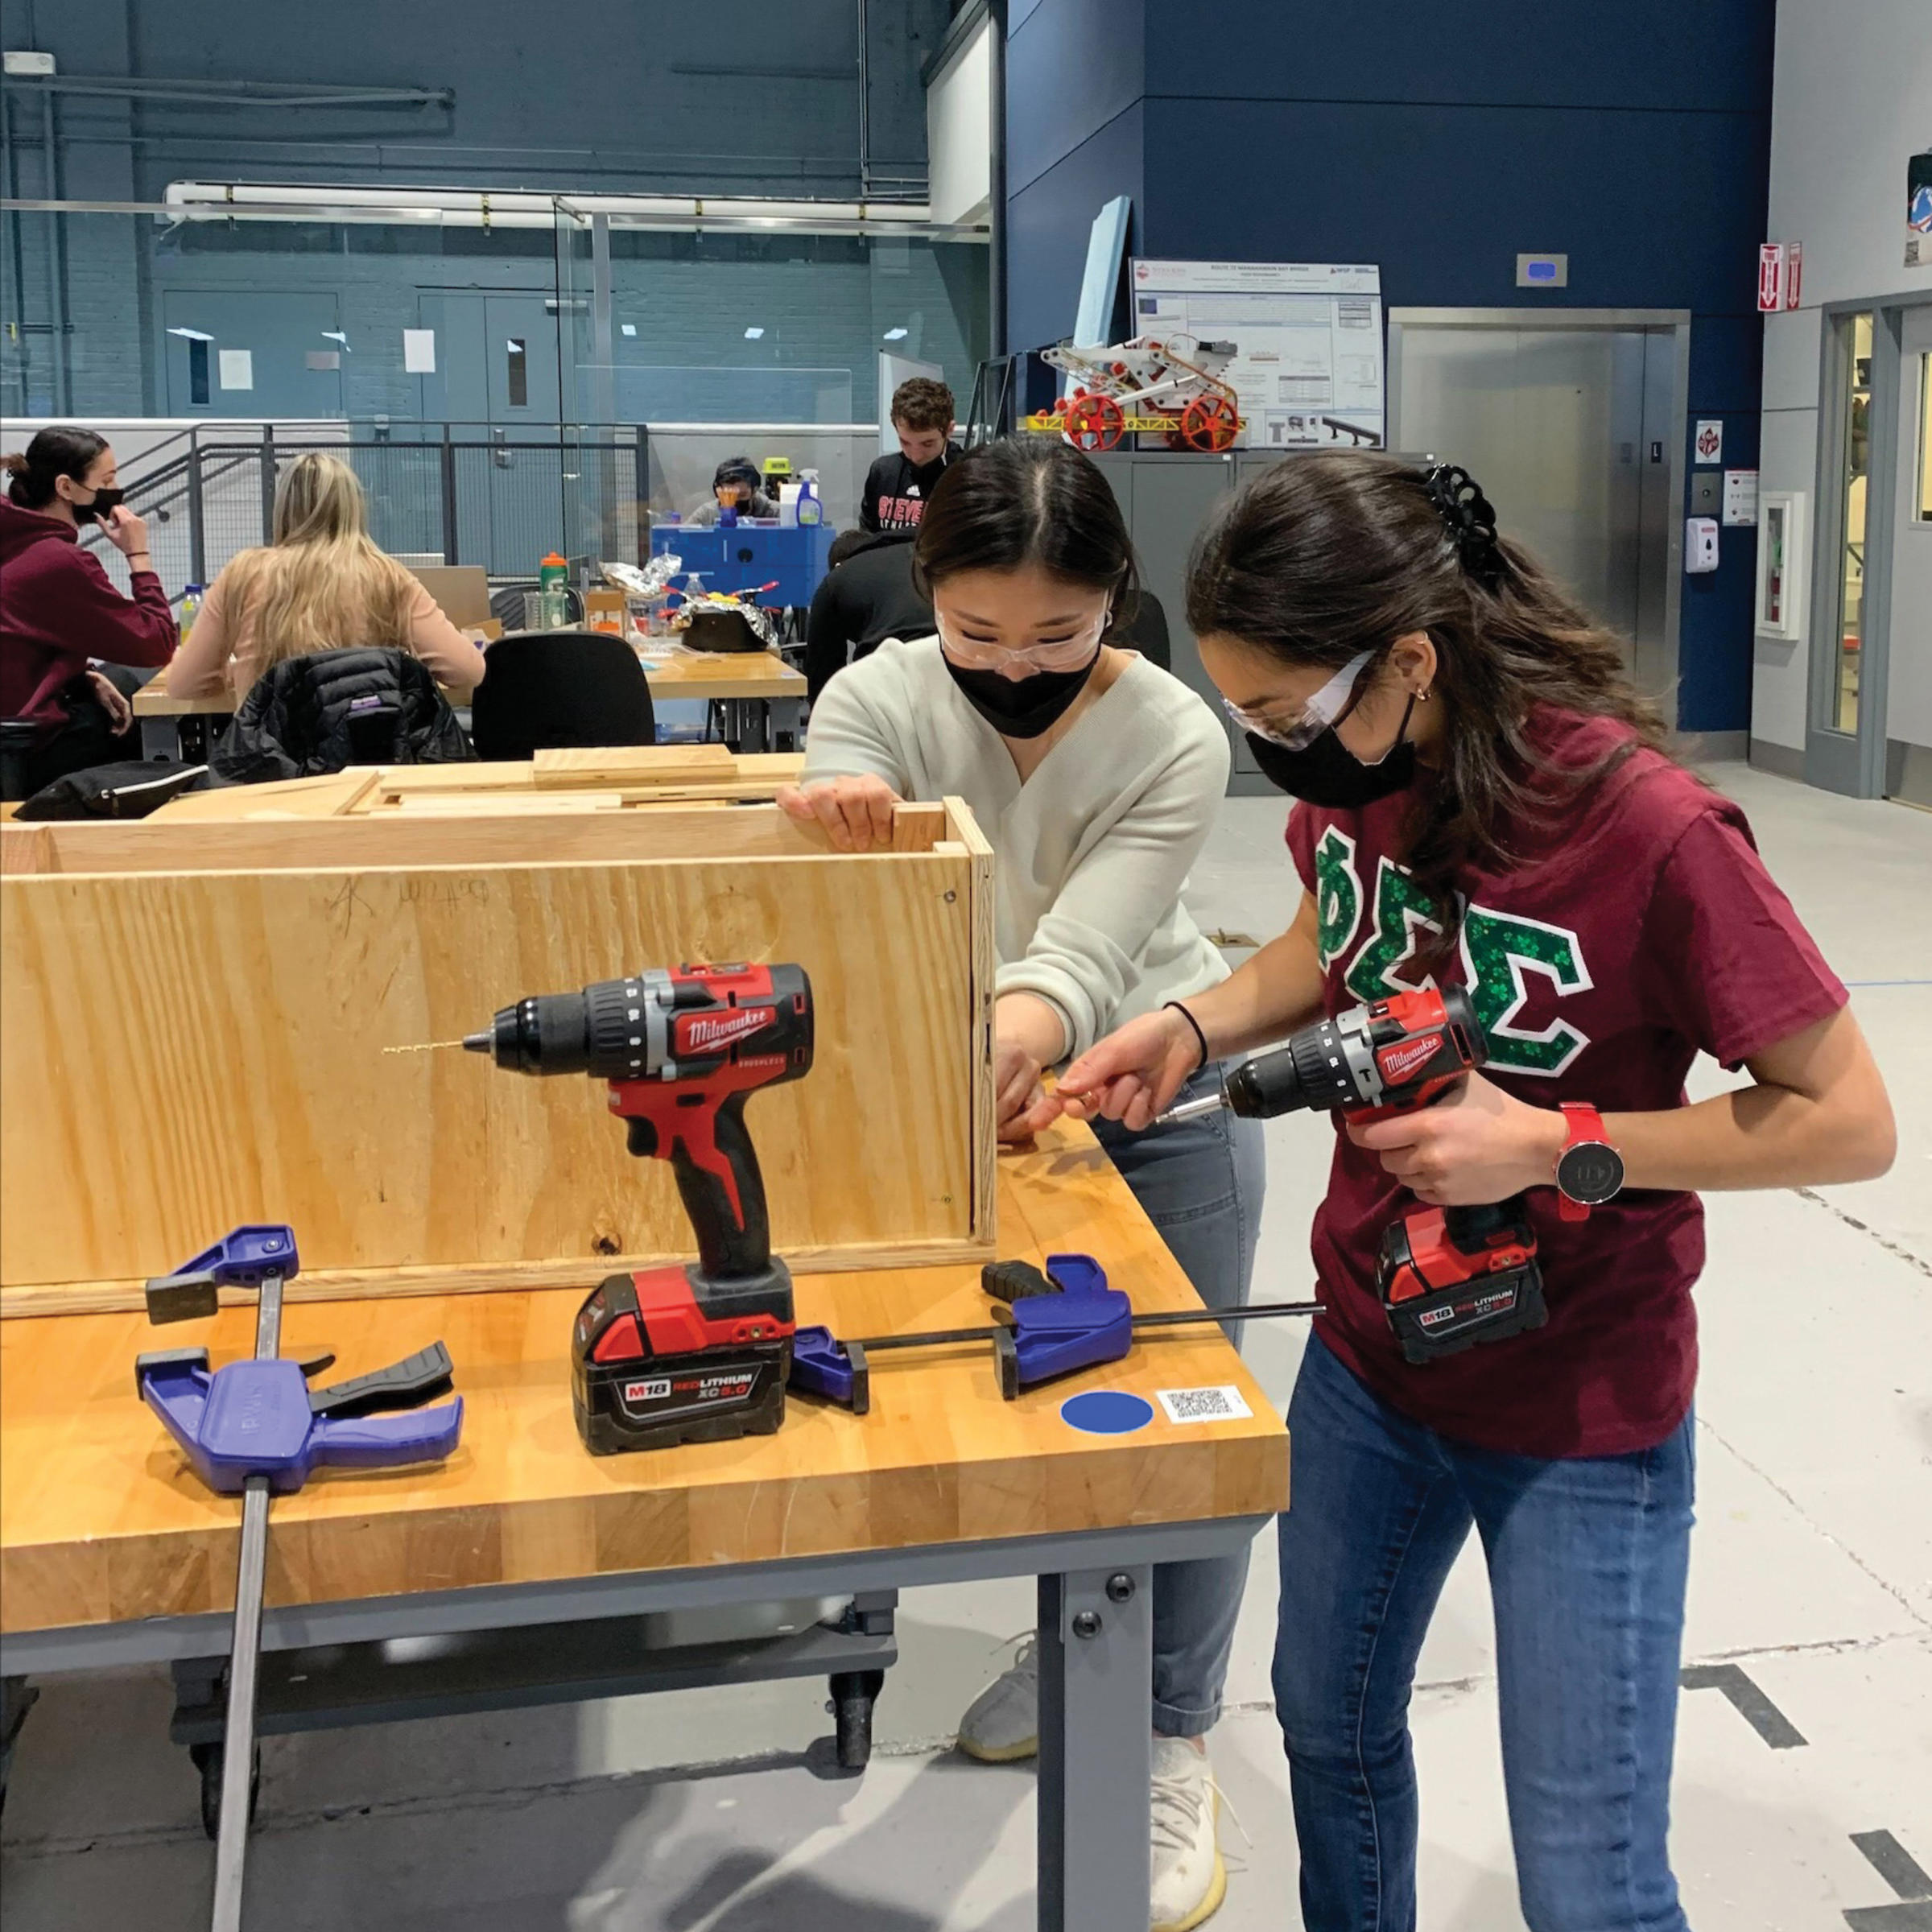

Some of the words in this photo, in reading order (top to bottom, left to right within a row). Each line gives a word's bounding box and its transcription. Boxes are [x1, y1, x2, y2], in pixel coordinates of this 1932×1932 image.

[687, 1009, 767, 1046] Milwaukee
[1384, 1037, 1439, 1073] Milwaukee
[1421, 1309, 1451, 1323] M18
[629, 1383, 667, 1398] M18
